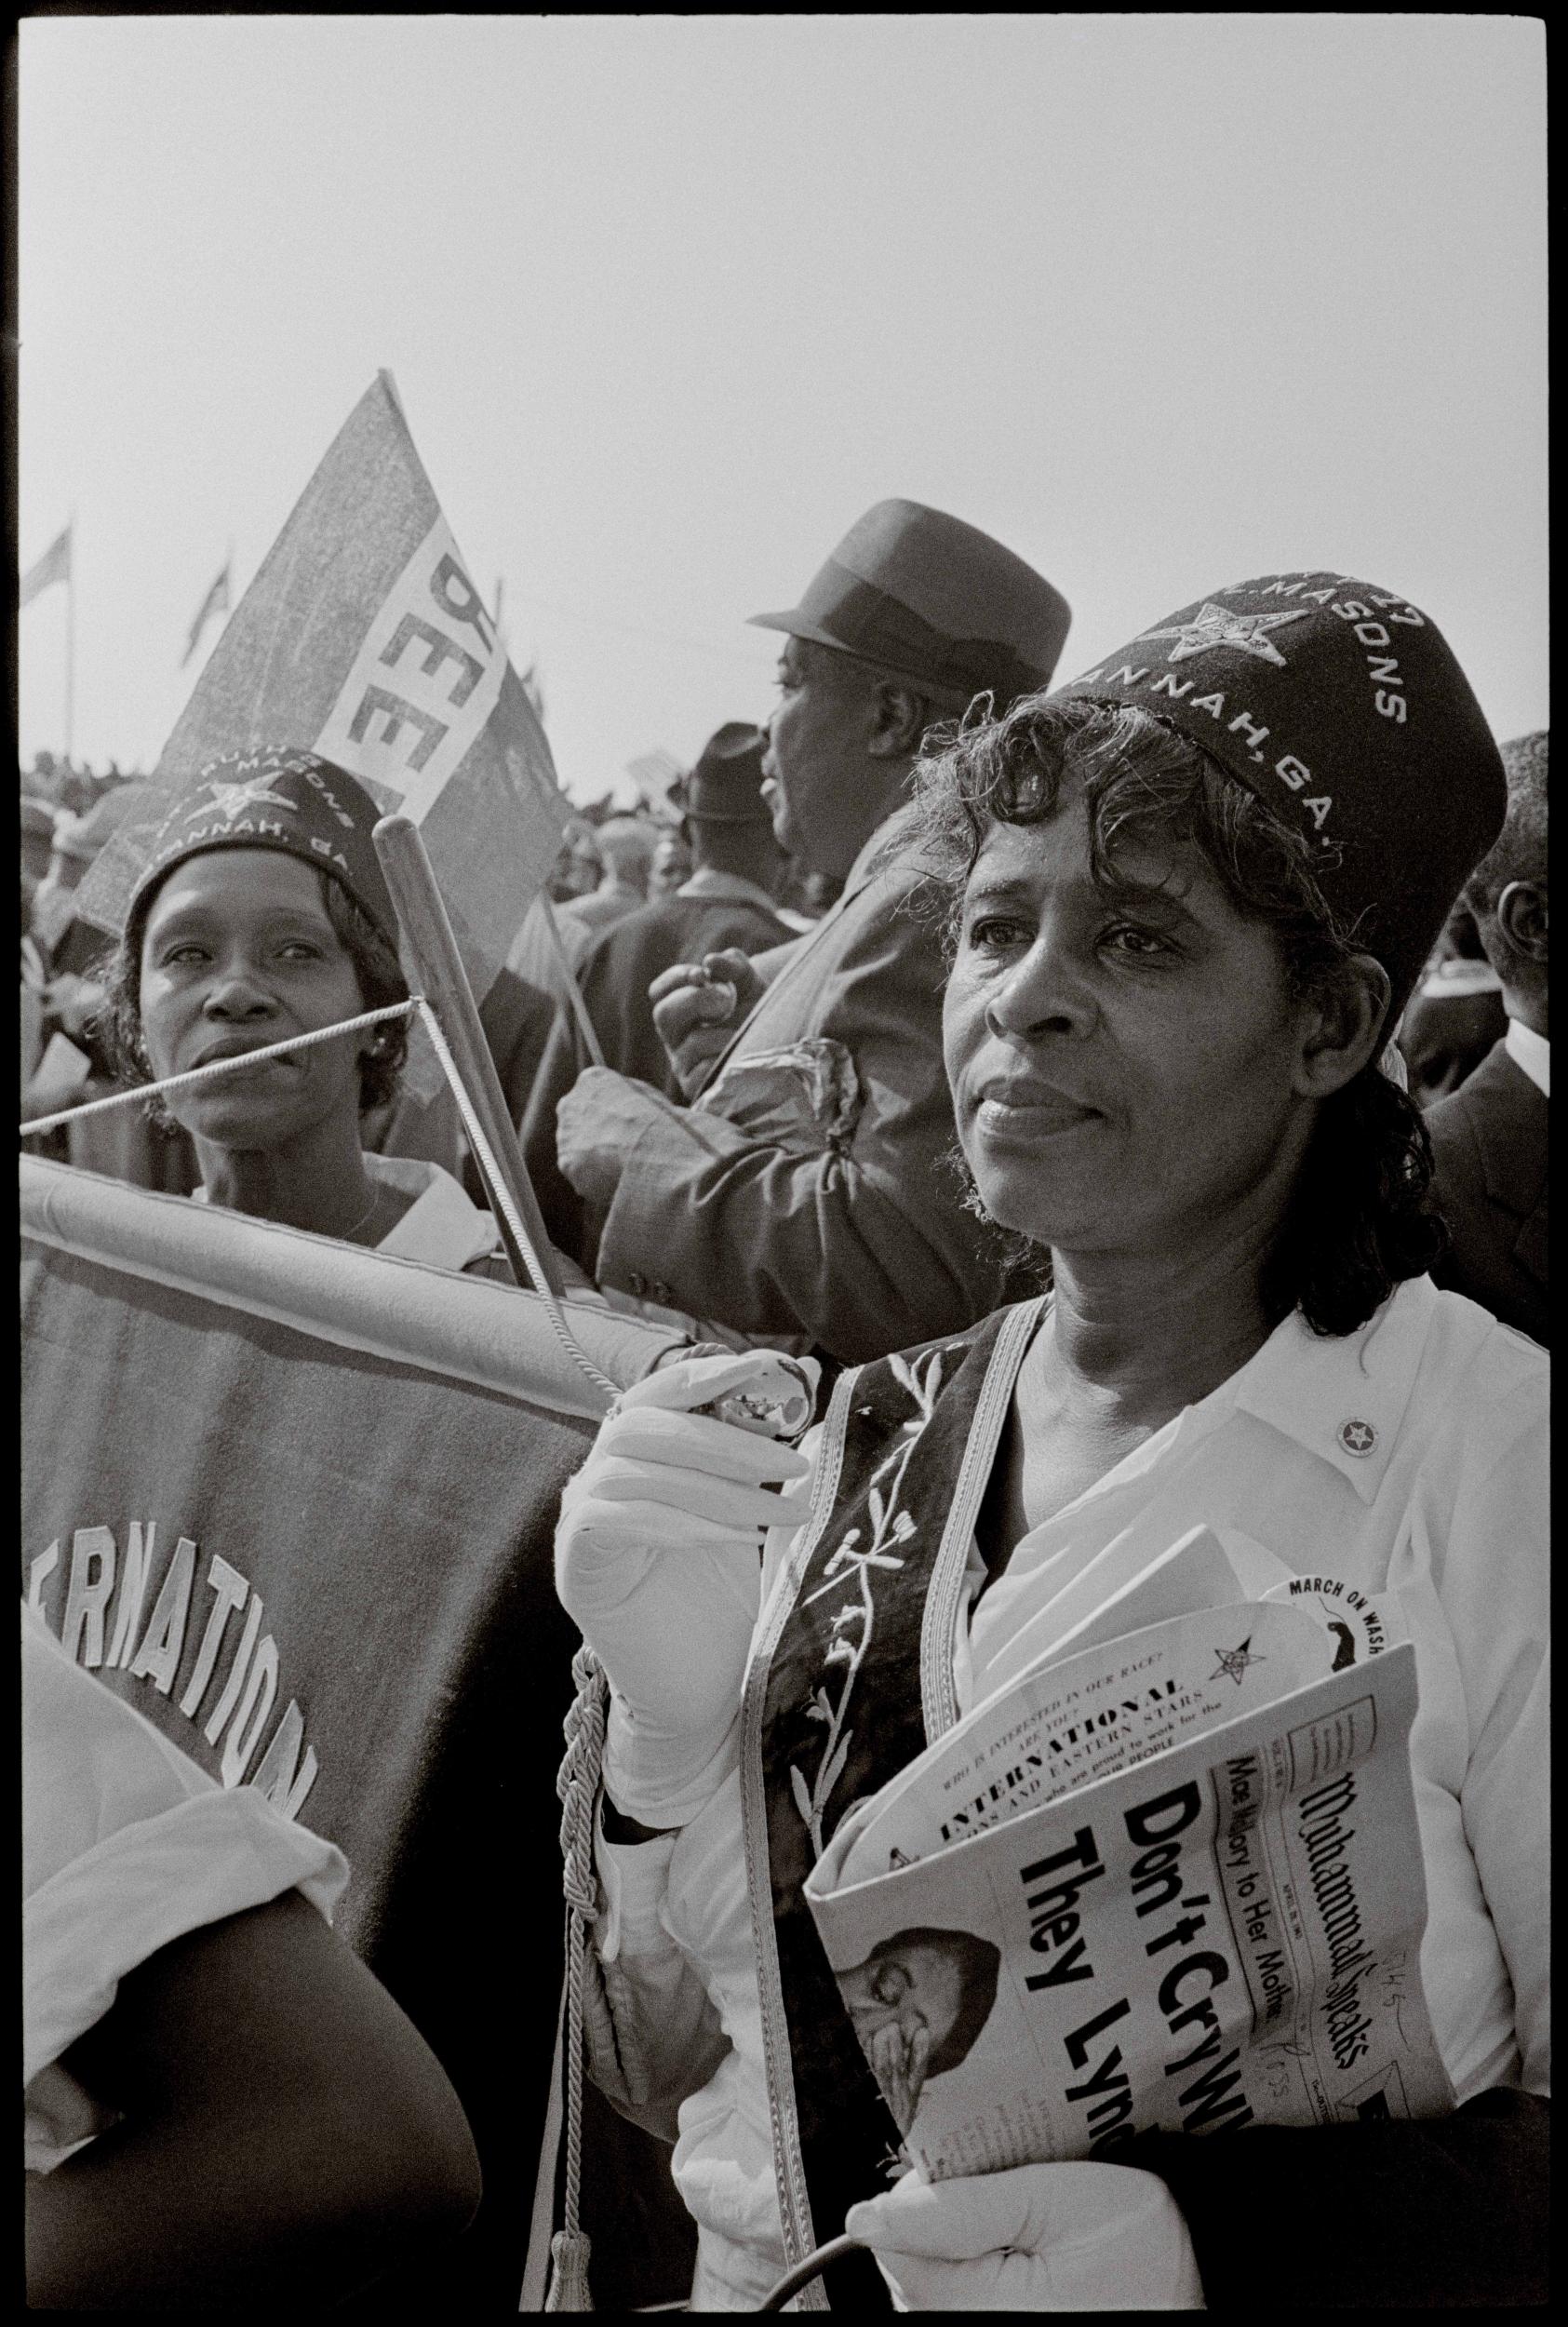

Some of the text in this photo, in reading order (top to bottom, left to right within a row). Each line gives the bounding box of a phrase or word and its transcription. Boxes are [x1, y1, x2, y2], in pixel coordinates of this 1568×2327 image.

[1274, 754, 1333, 847] GA.
[1289, 1577, 1346, 1598] MARCH
[1347, 1591, 1369, 1612] ON
[989, 1700, 1061, 1757] INTERESTED
[1066, 1688, 1080, 1704] IN
[1085, 1674, 1114, 1694] OUR
[1120, 1651, 1163, 1678] RACE?
[1010, 1778, 1040, 1809] AND
[1050, 1724, 1132, 1779] EASTERN
[1144, 1689, 1203, 1726] STARS
[1019, 1707, 1079, 1752] ARE YOU?
[1071, 1769, 1089, 1786] are
[1092, 1746, 1126, 1773] proud
[1130, 1739, 1144, 1751] to
[1146, 1723, 1175, 1742] work
[1179, 1712, 1197, 1726] for
[1201, 1701, 1223, 1715] the
[1129, 1736, 1174, 1766] PEOPLE
[940, 1678, 1184, 1842] INTERNATIONAL
[1226, 1755, 1257, 1805] Mae
[1020, 1825, 1106, 1992] They
[1124, 1780, 1211, 1957] Don't
[1236, 1872, 1260, 1898] to
[1299, 1771, 1374, 1980] Muhammad
[1243, 1899, 1271, 1943] Her
[1158, 1951, 1230, 2078] Cry
[1320, 1962, 1379, 2070] Speaks
